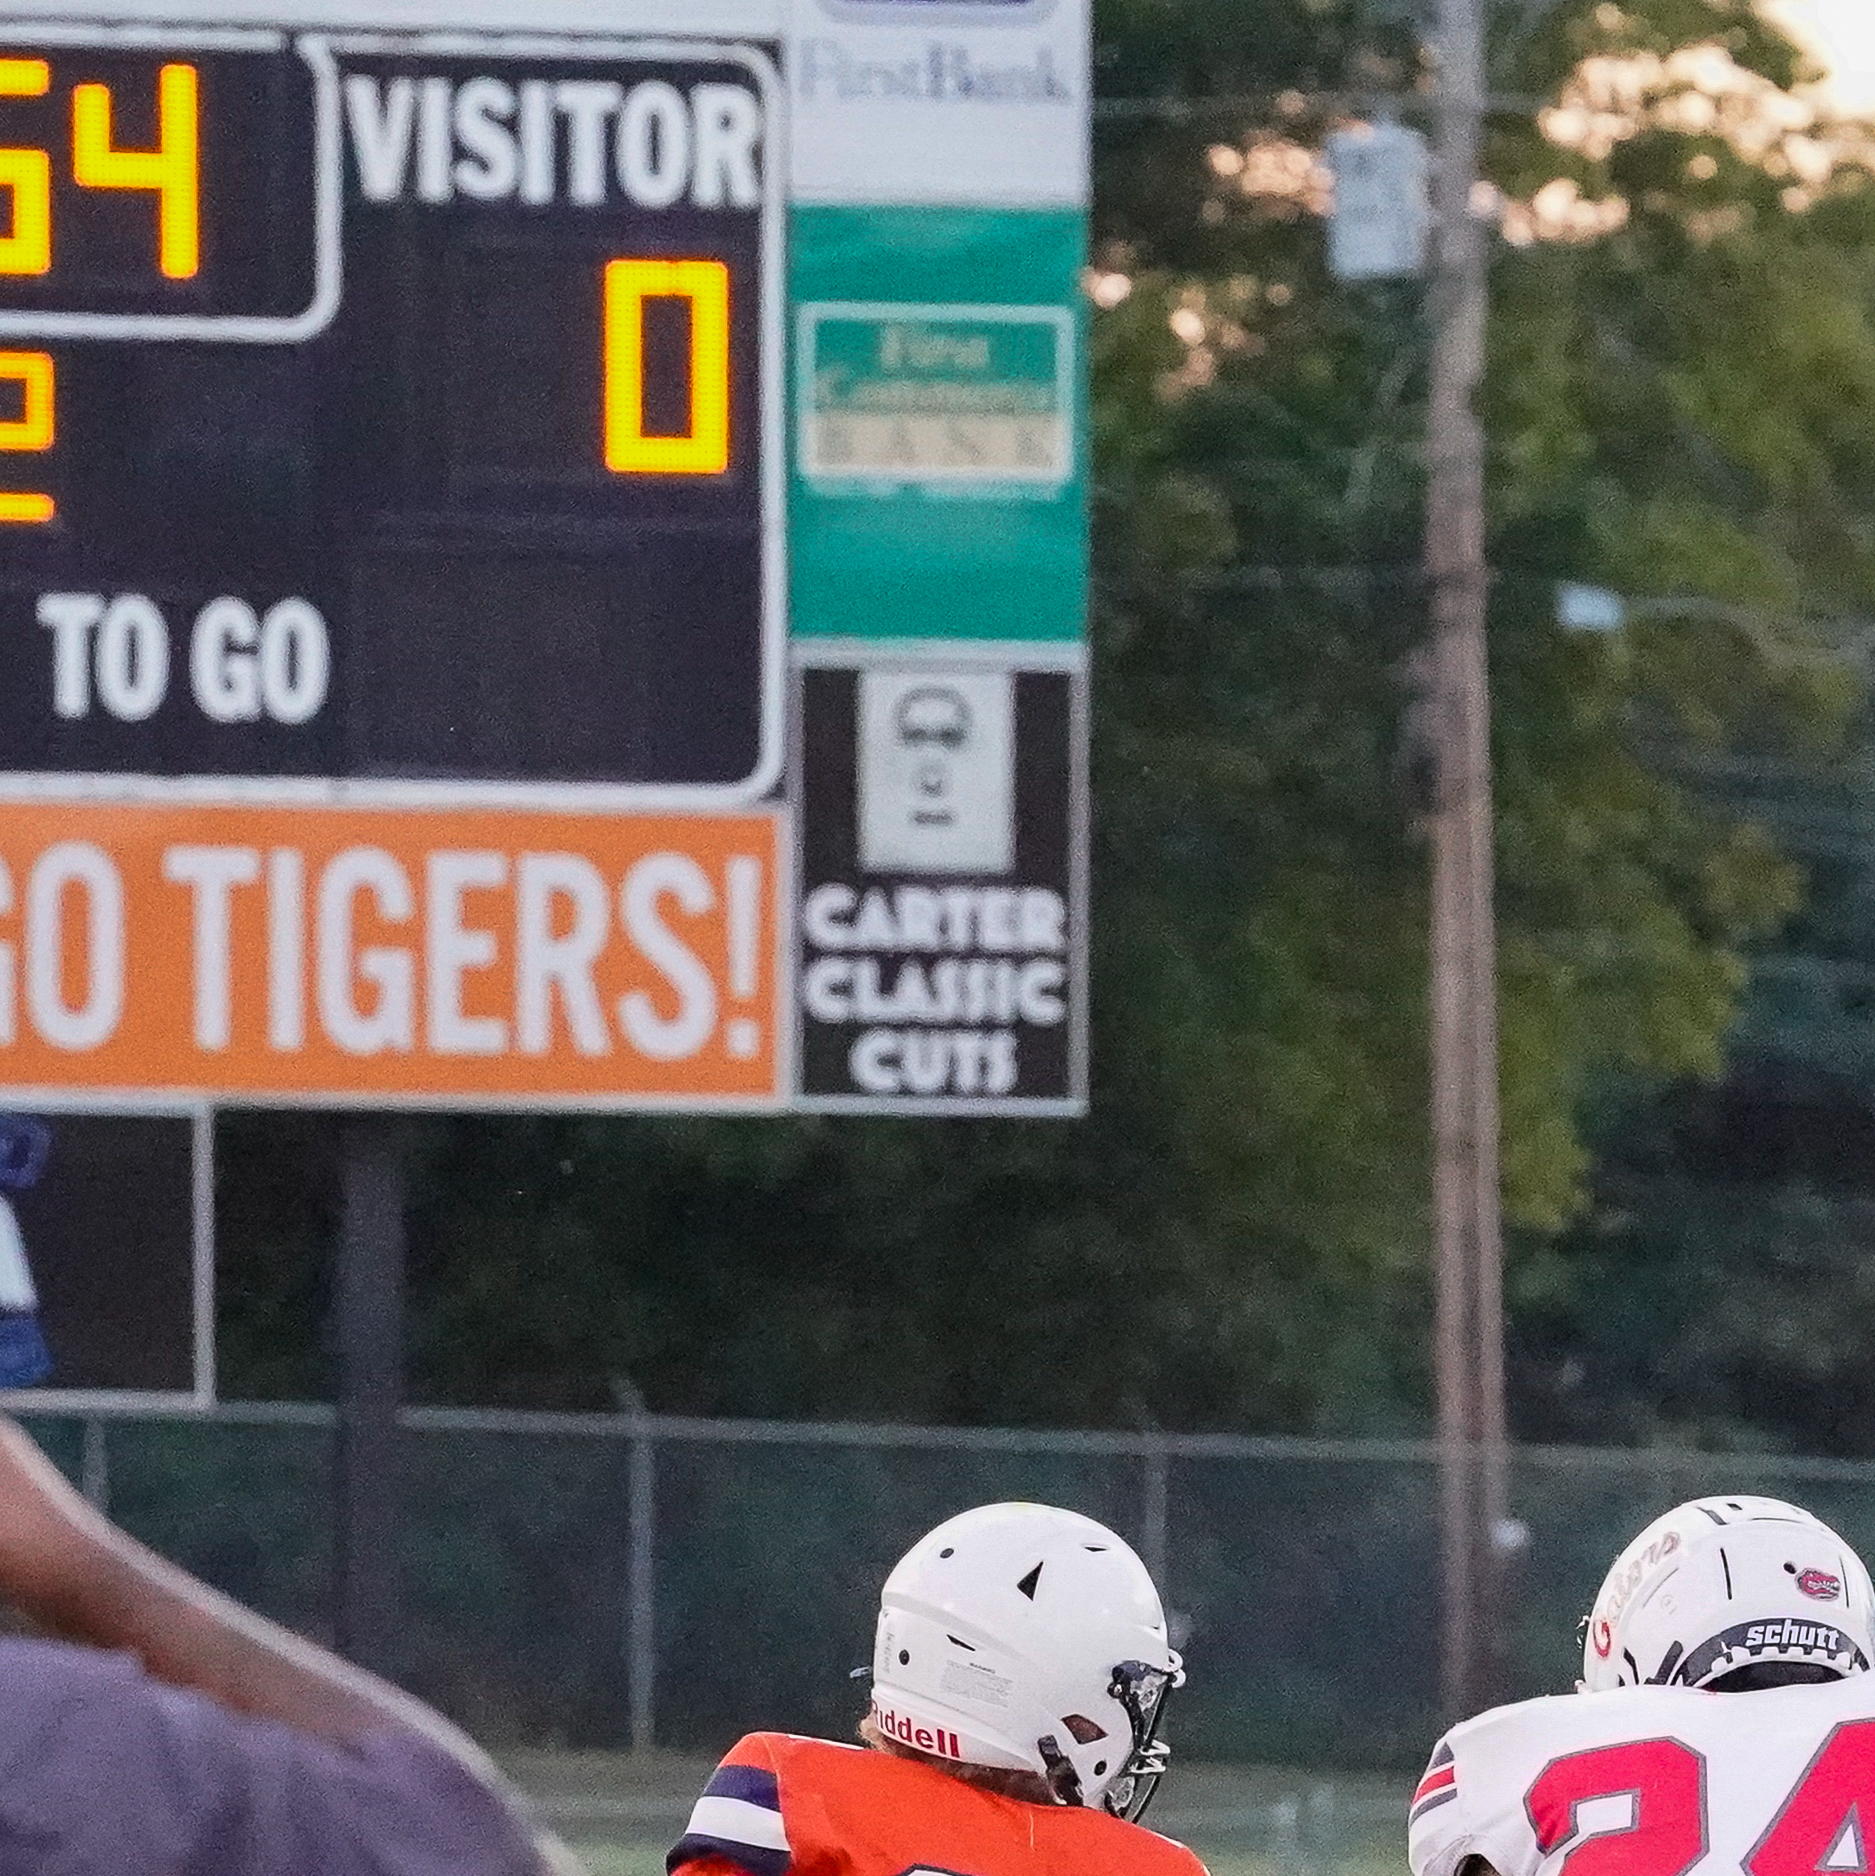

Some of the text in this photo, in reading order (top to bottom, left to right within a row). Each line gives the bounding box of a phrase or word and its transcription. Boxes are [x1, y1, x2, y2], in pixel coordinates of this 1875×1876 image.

[344, 74, 761, 210] VISITOR
[605, 259, 728, 473] 0
[36, 592, 330, 726] TO GO
[162, 846, 761, 1060] TIGERS!
[804, 882, 1066, 952] CARTER
[804, 955, 1067, 1026] CLASSIC
[848, 1027, 1020, 1093] CUTS
[1745, 1618, 1840, 1650] schutt
